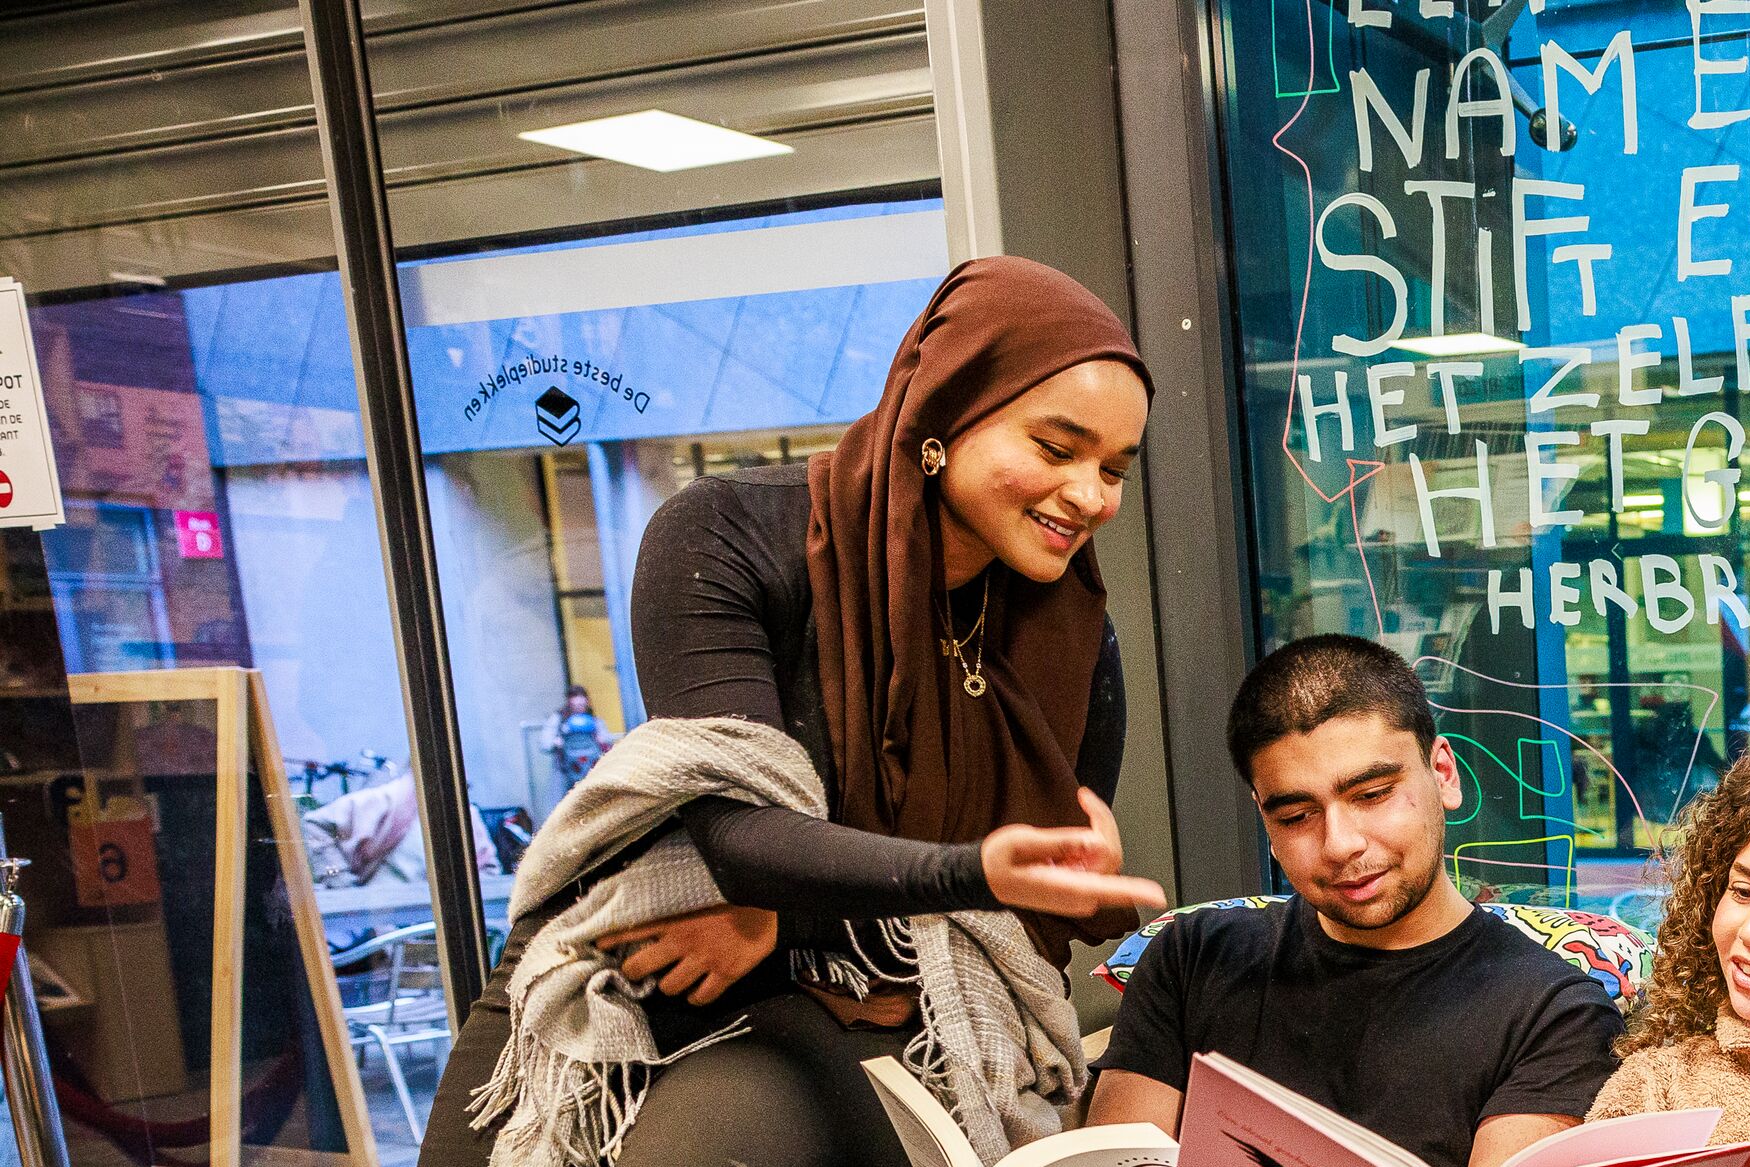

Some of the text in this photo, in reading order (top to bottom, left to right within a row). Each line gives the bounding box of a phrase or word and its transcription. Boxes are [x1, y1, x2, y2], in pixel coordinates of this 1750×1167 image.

[1349, 30, 1638, 172] NAM
[1316, 178, 1612, 356] STIFT
[1409, 419, 1651, 558] HET
